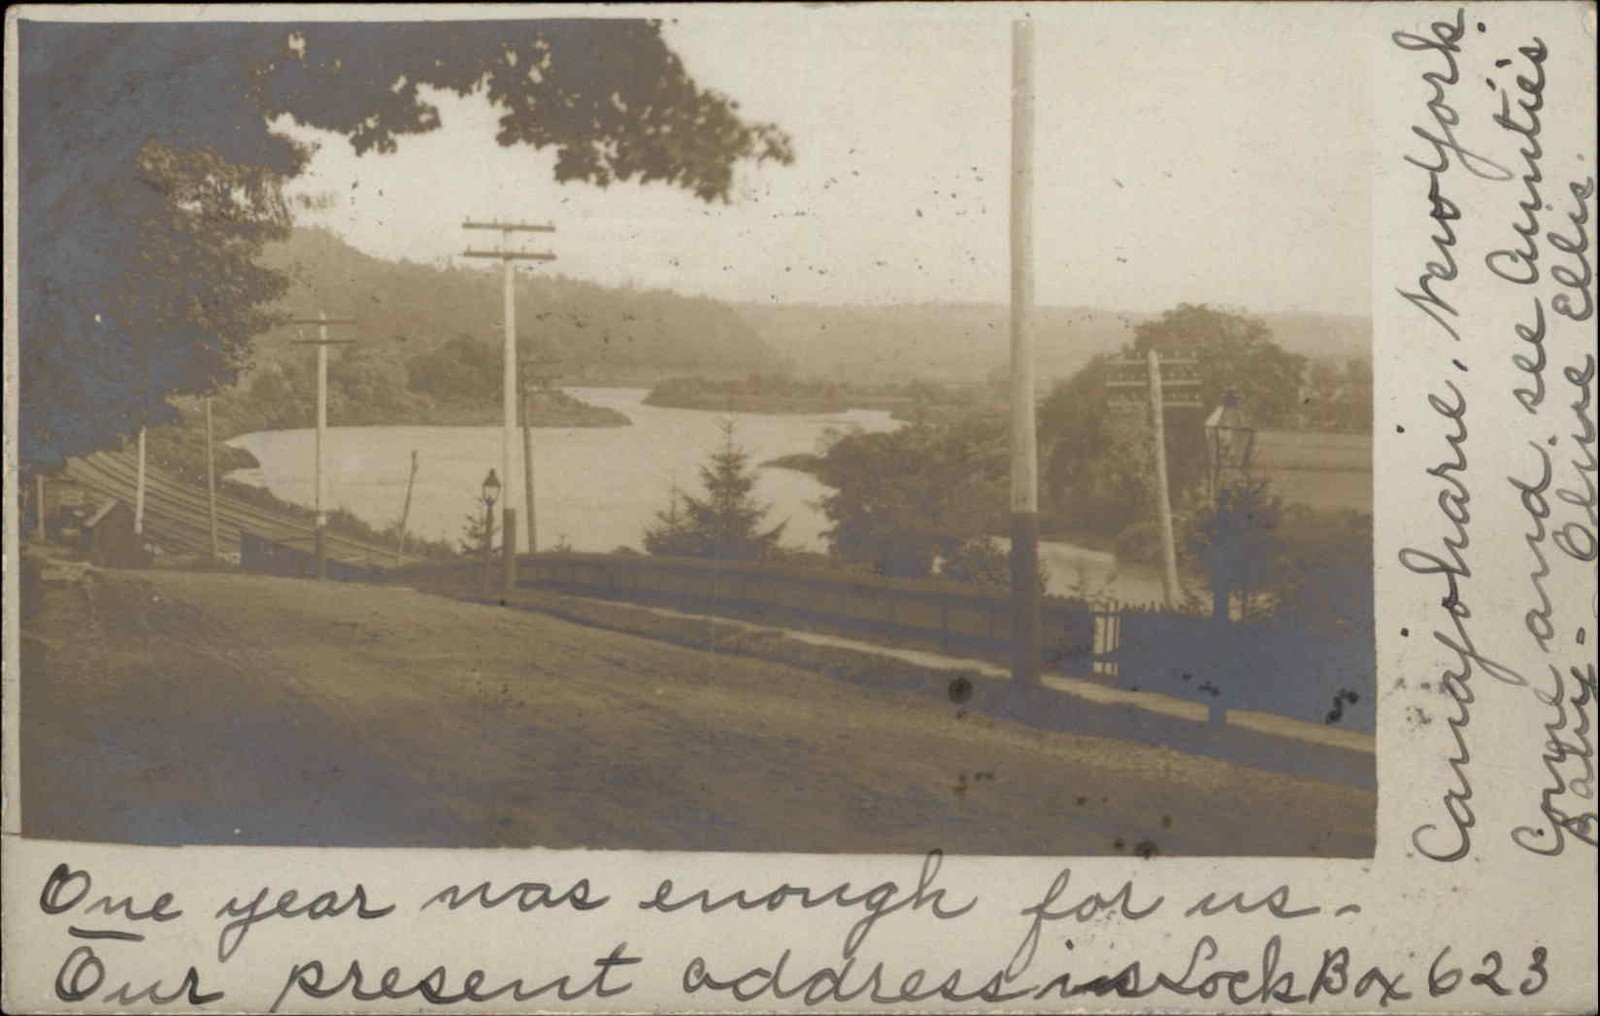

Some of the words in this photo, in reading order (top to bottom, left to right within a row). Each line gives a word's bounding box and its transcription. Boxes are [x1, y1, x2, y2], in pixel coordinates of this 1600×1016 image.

[1394, 172, 1461, 341] New
[1511, 295, 1546, 414] see
[1510, 663, 1568, 856] Come
[40, 863, 183, 922] One
[215, 886, 396, 962] year
[420, 879, 611, 911] was
[638, 848, 979, 960] enough
[1021, 868, 1166, 984] for
[54, 945, 225, 1005] Our
[270, 942, 643, 1013] present
[682, 948, 1040, 1005] address
[1157, 935, 1308, 1004] Lock
[1308, 946, 1412, 1007] Box
[1428, 945, 1550, 997] 623
